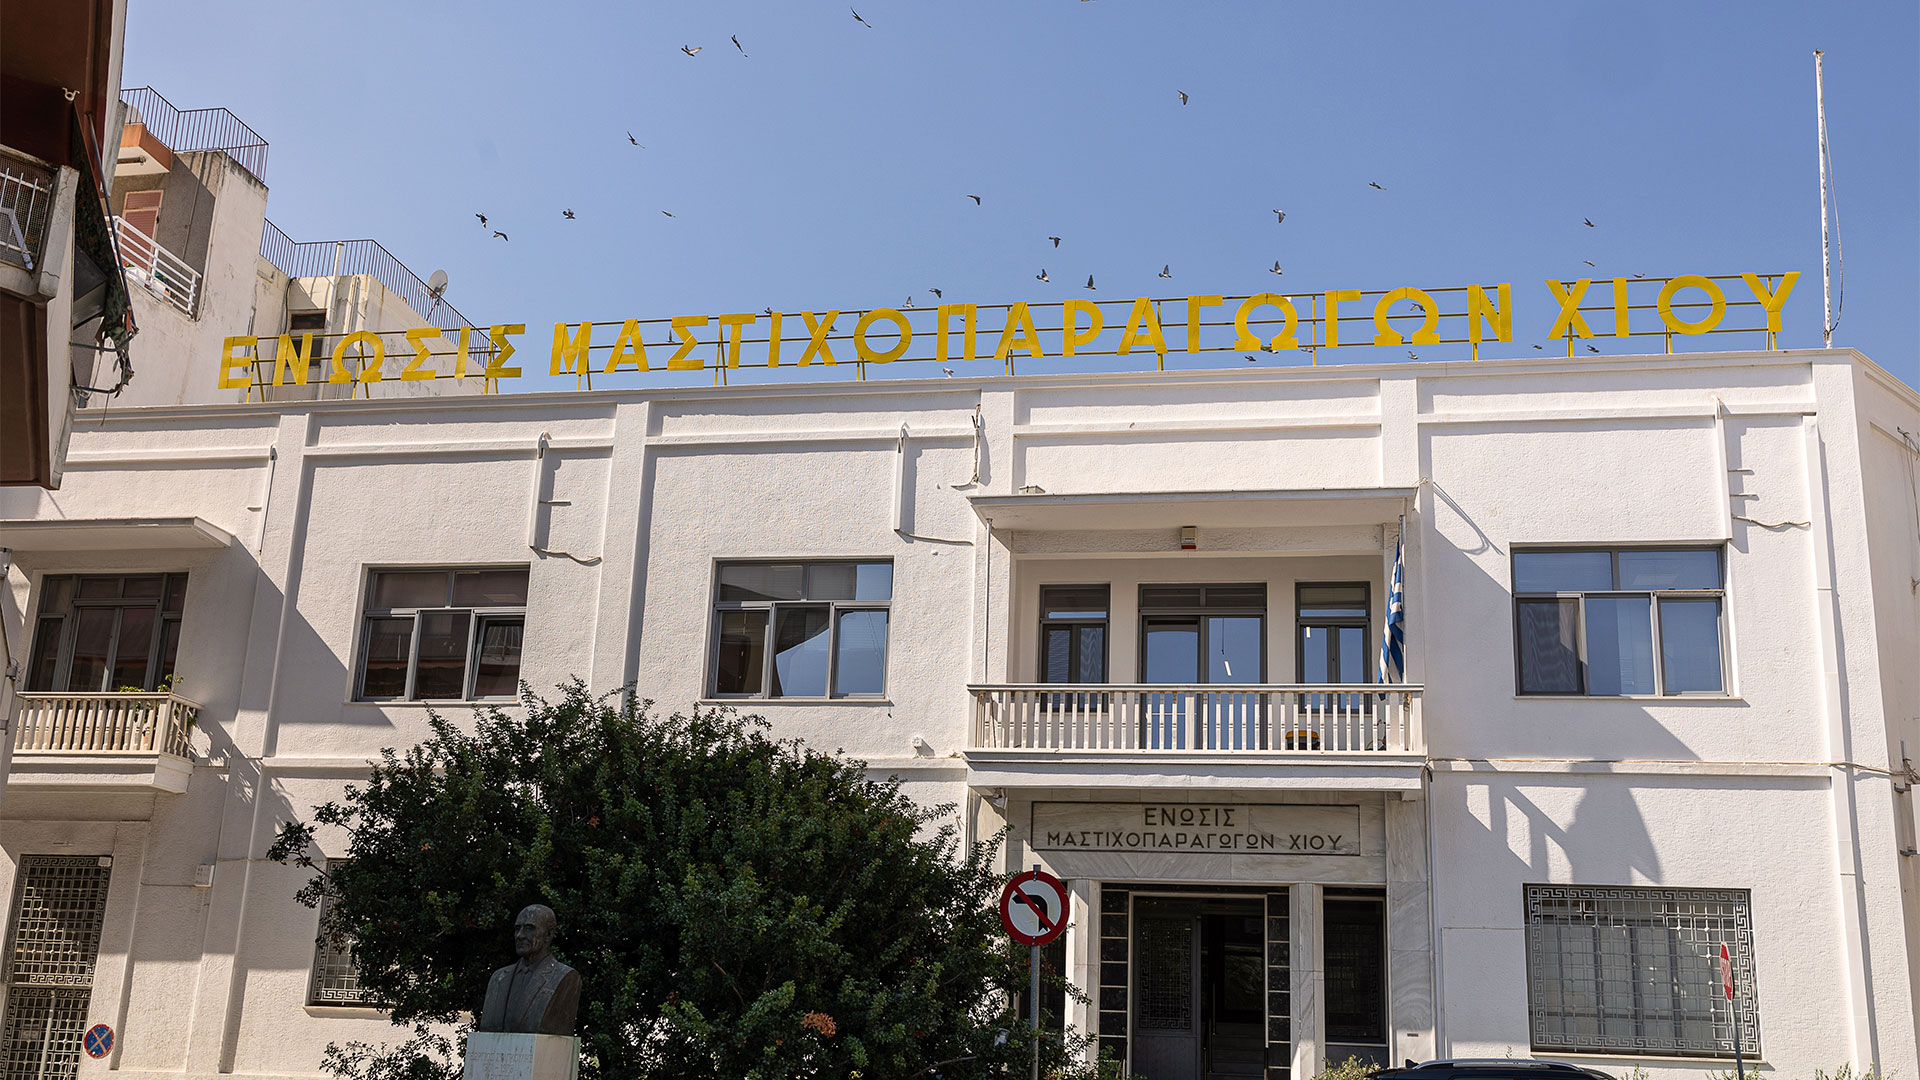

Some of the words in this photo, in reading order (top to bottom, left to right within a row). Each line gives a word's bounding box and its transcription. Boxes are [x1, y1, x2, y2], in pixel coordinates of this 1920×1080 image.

[218, 324, 526, 390] ΕΝΩΣΙΣ
[549, 283, 1513, 377] ΜΑΣΤΙΧΟΠΑΡΑΓΩΓΩΝ
[1545, 271, 1801, 341] ΧΙΟΥ
[1144, 807, 1235, 827] ΕΝΩΣΙΣ
[1047, 831, 1275, 849] ΜΑΣΤΙΧΟΠΑΡΑΓΩΓΩΝ
[1289, 834, 1342, 850] ΧΙΟΥ
